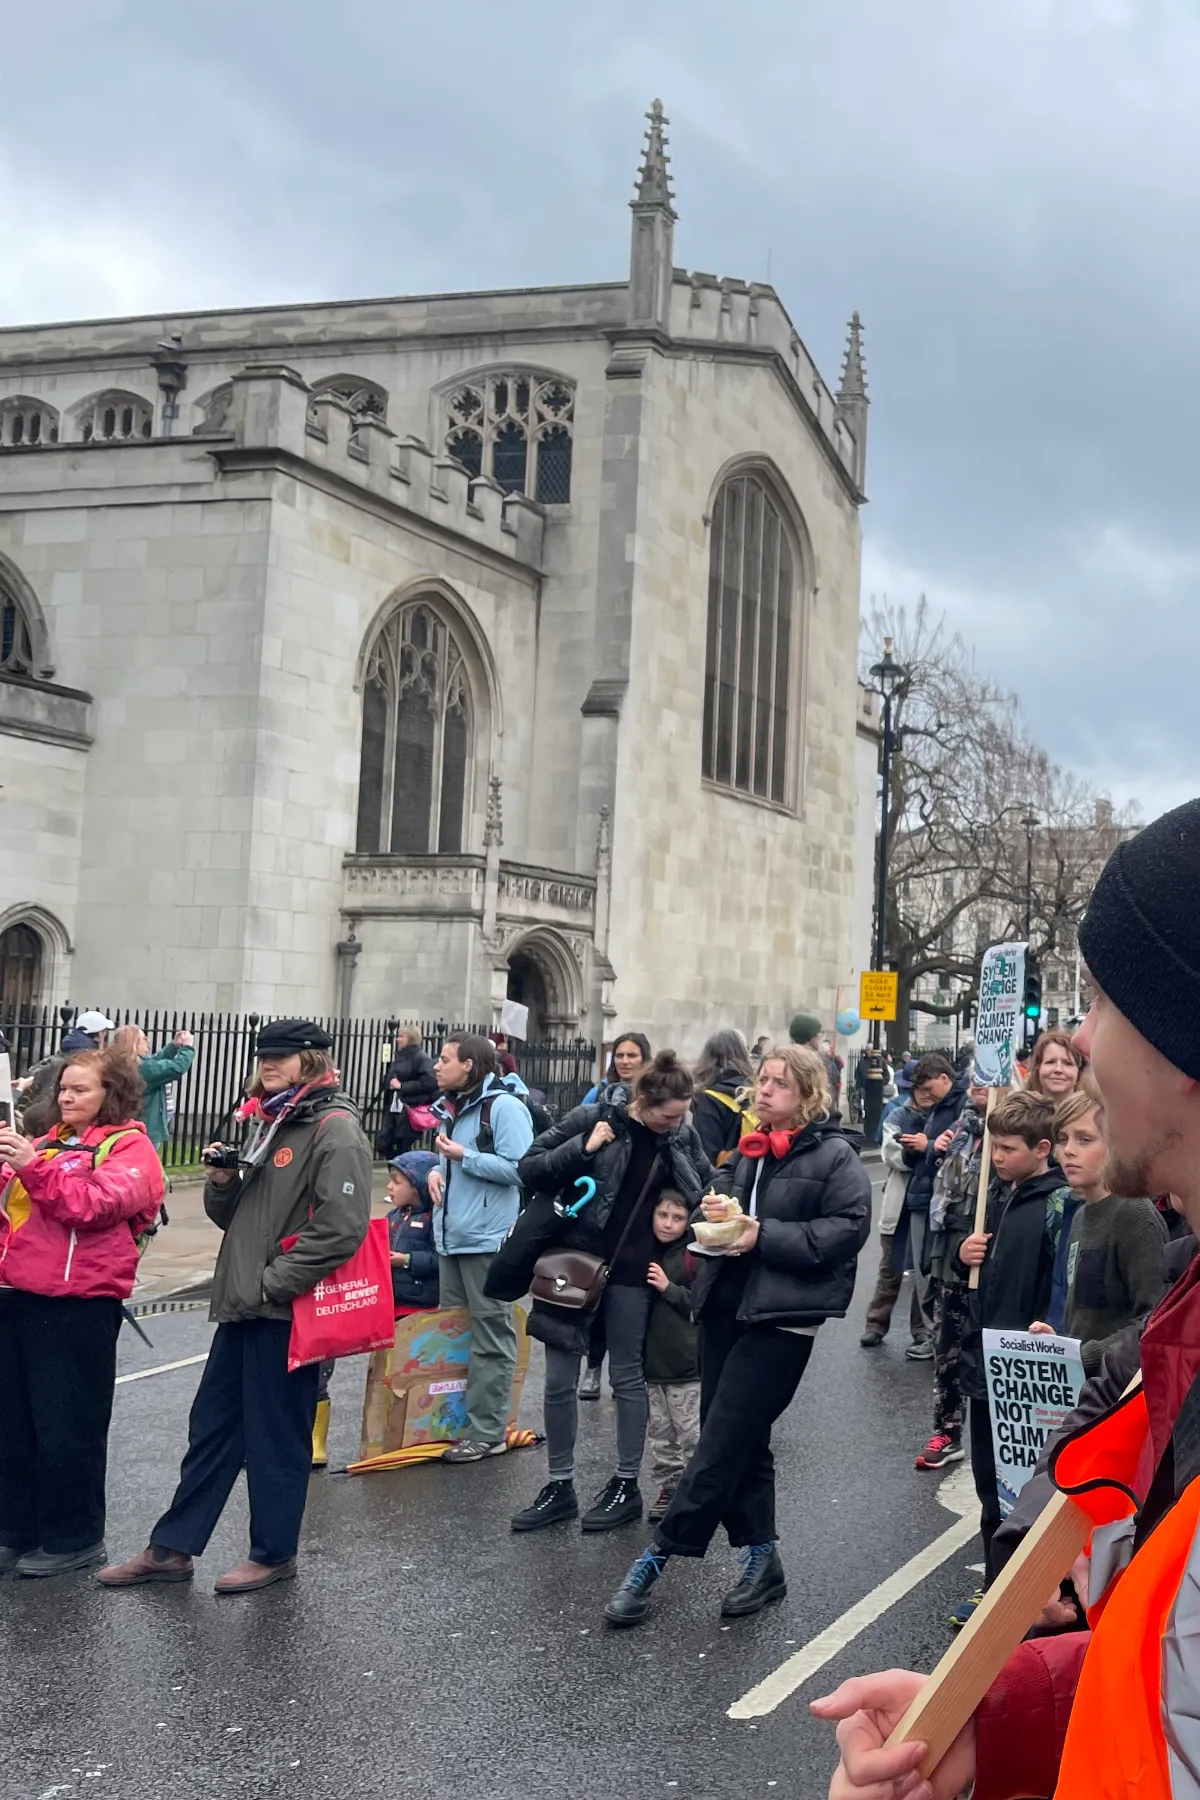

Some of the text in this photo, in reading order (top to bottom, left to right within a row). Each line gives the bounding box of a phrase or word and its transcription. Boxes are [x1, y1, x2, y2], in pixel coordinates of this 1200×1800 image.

[980, 997, 997, 1013] NOT
[978, 1012, 1016, 1029] CLIMATE
[977, 1028, 1014, 1045] CHANGE
[316, 1296, 378, 1317] DEUTSCHLAND
[1000, 1337, 1066, 1355] Socialist Worker
[989, 1356, 1068, 1384] SYSTEM
[992, 1378, 1075, 1407] CHANGE
[995, 1400, 1032, 1425] NOT
[997, 1422, 1053, 1449] CLIM
[999, 1444, 1041, 1468] CHA
